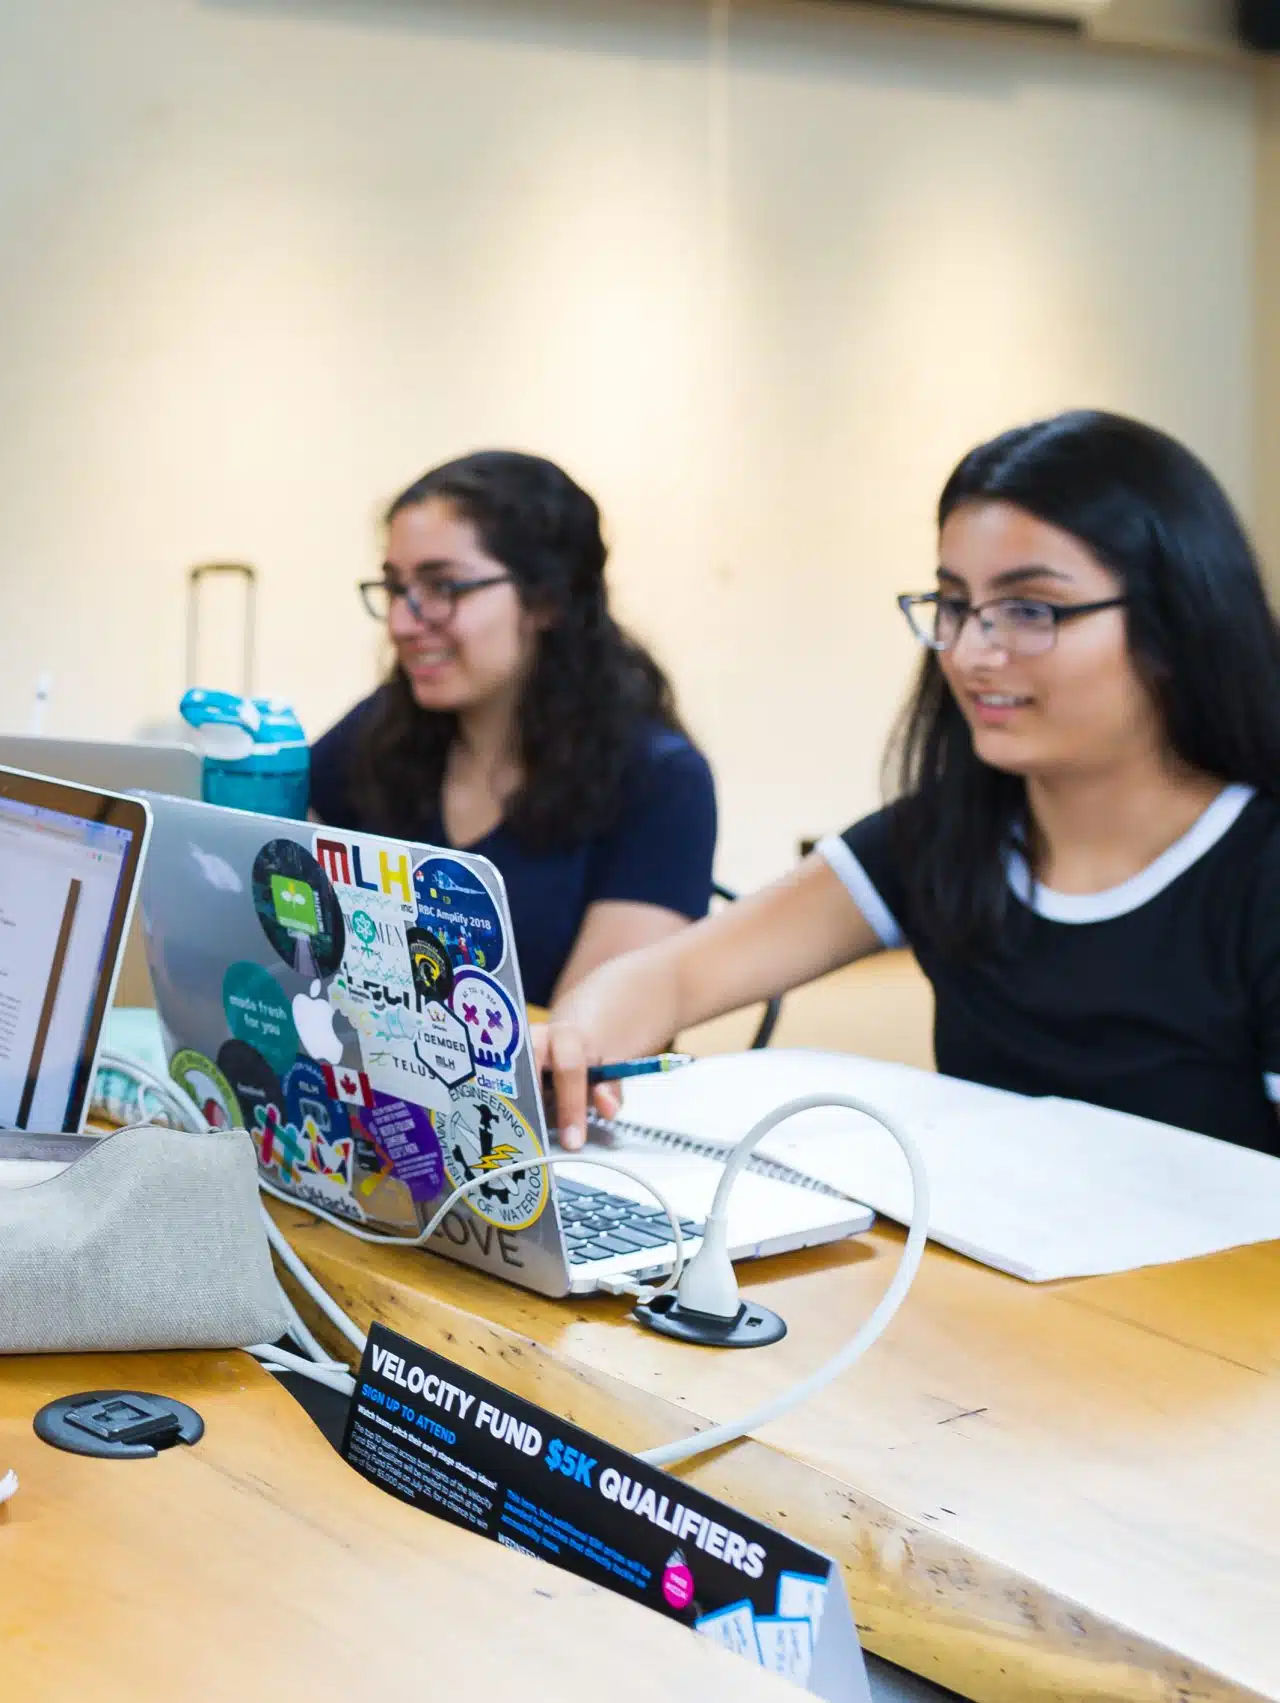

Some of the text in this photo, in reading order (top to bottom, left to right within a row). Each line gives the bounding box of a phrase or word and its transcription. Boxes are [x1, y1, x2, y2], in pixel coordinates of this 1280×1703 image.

[316, 838, 412, 903] MLH
[436, 908, 468, 927] Amplify
[468, 916, 492, 930] 2018
[258, 999, 288, 1020] fresh
[243, 1012, 281, 1036] for you
[424, 1032, 467, 1053] DEMOED
[392, 1055, 436, 1080] TELUS
[448, 1084, 526, 1138] ENGINEERING
[361, 1383, 457, 1445] SIGN UP TO ATTEND
[372, 1343, 767, 1579] VELOCITY FUND $5K QUALIFIERS
